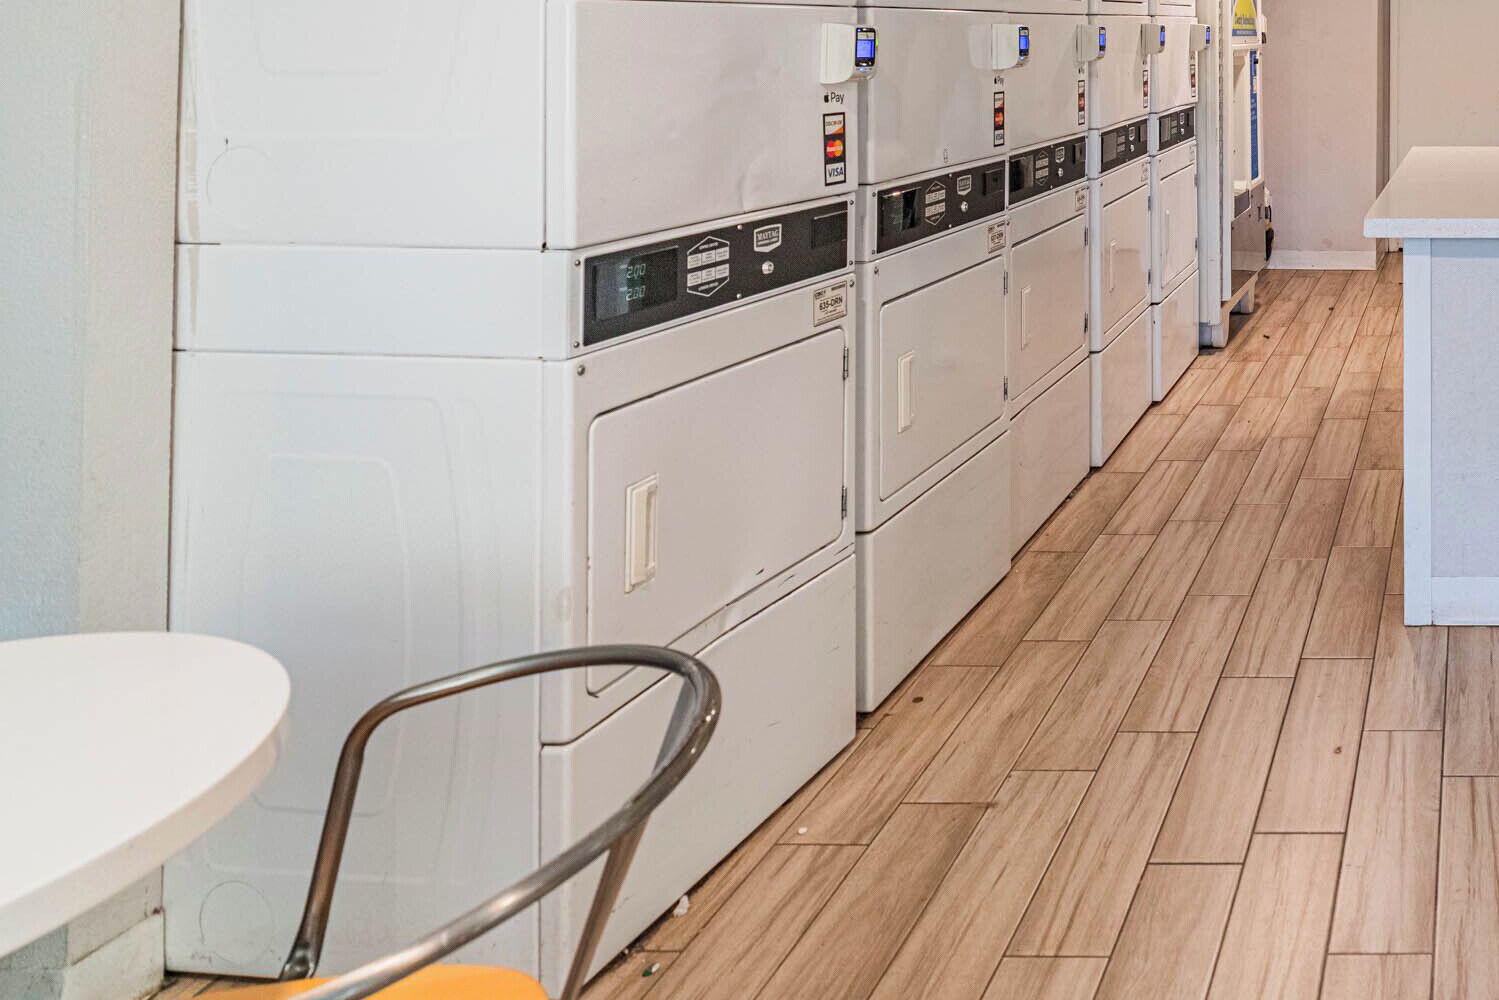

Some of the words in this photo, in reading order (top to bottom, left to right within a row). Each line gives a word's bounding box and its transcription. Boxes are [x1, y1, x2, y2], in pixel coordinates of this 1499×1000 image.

[830, 91, 845, 105] Pay
[828, 166, 844, 178] VISA
[757, 229, 779, 241] MAYTAG
